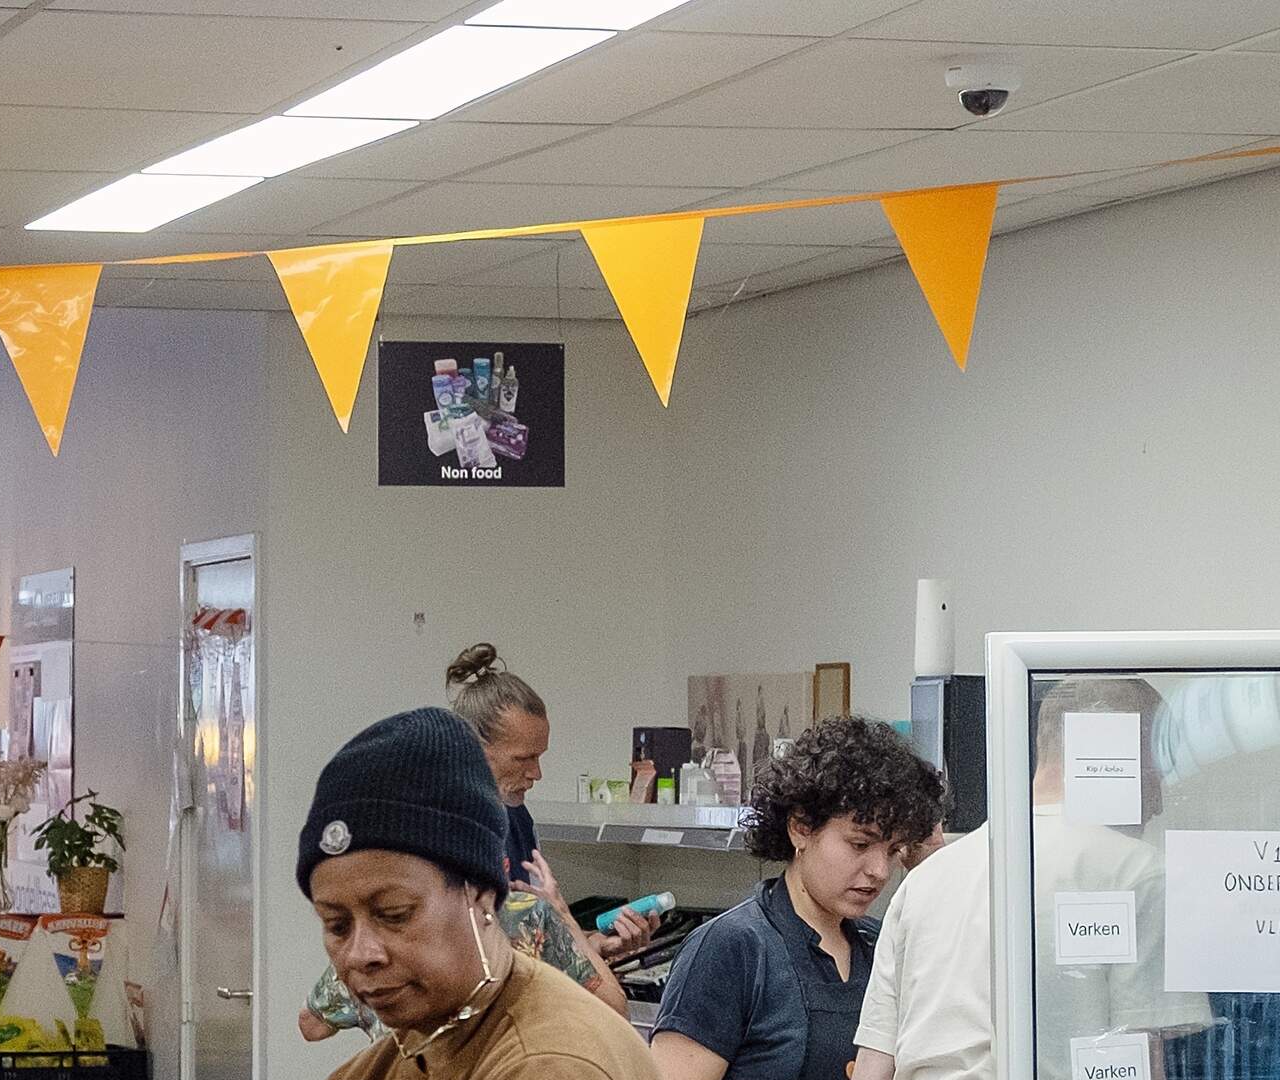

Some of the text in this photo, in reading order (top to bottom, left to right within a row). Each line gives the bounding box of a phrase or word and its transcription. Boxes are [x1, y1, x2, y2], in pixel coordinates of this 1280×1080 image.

[441, 466, 502, 479] Non food
[1068, 922, 1120, 937] Varken
[1085, 1065, 1137, 1080] Varken
